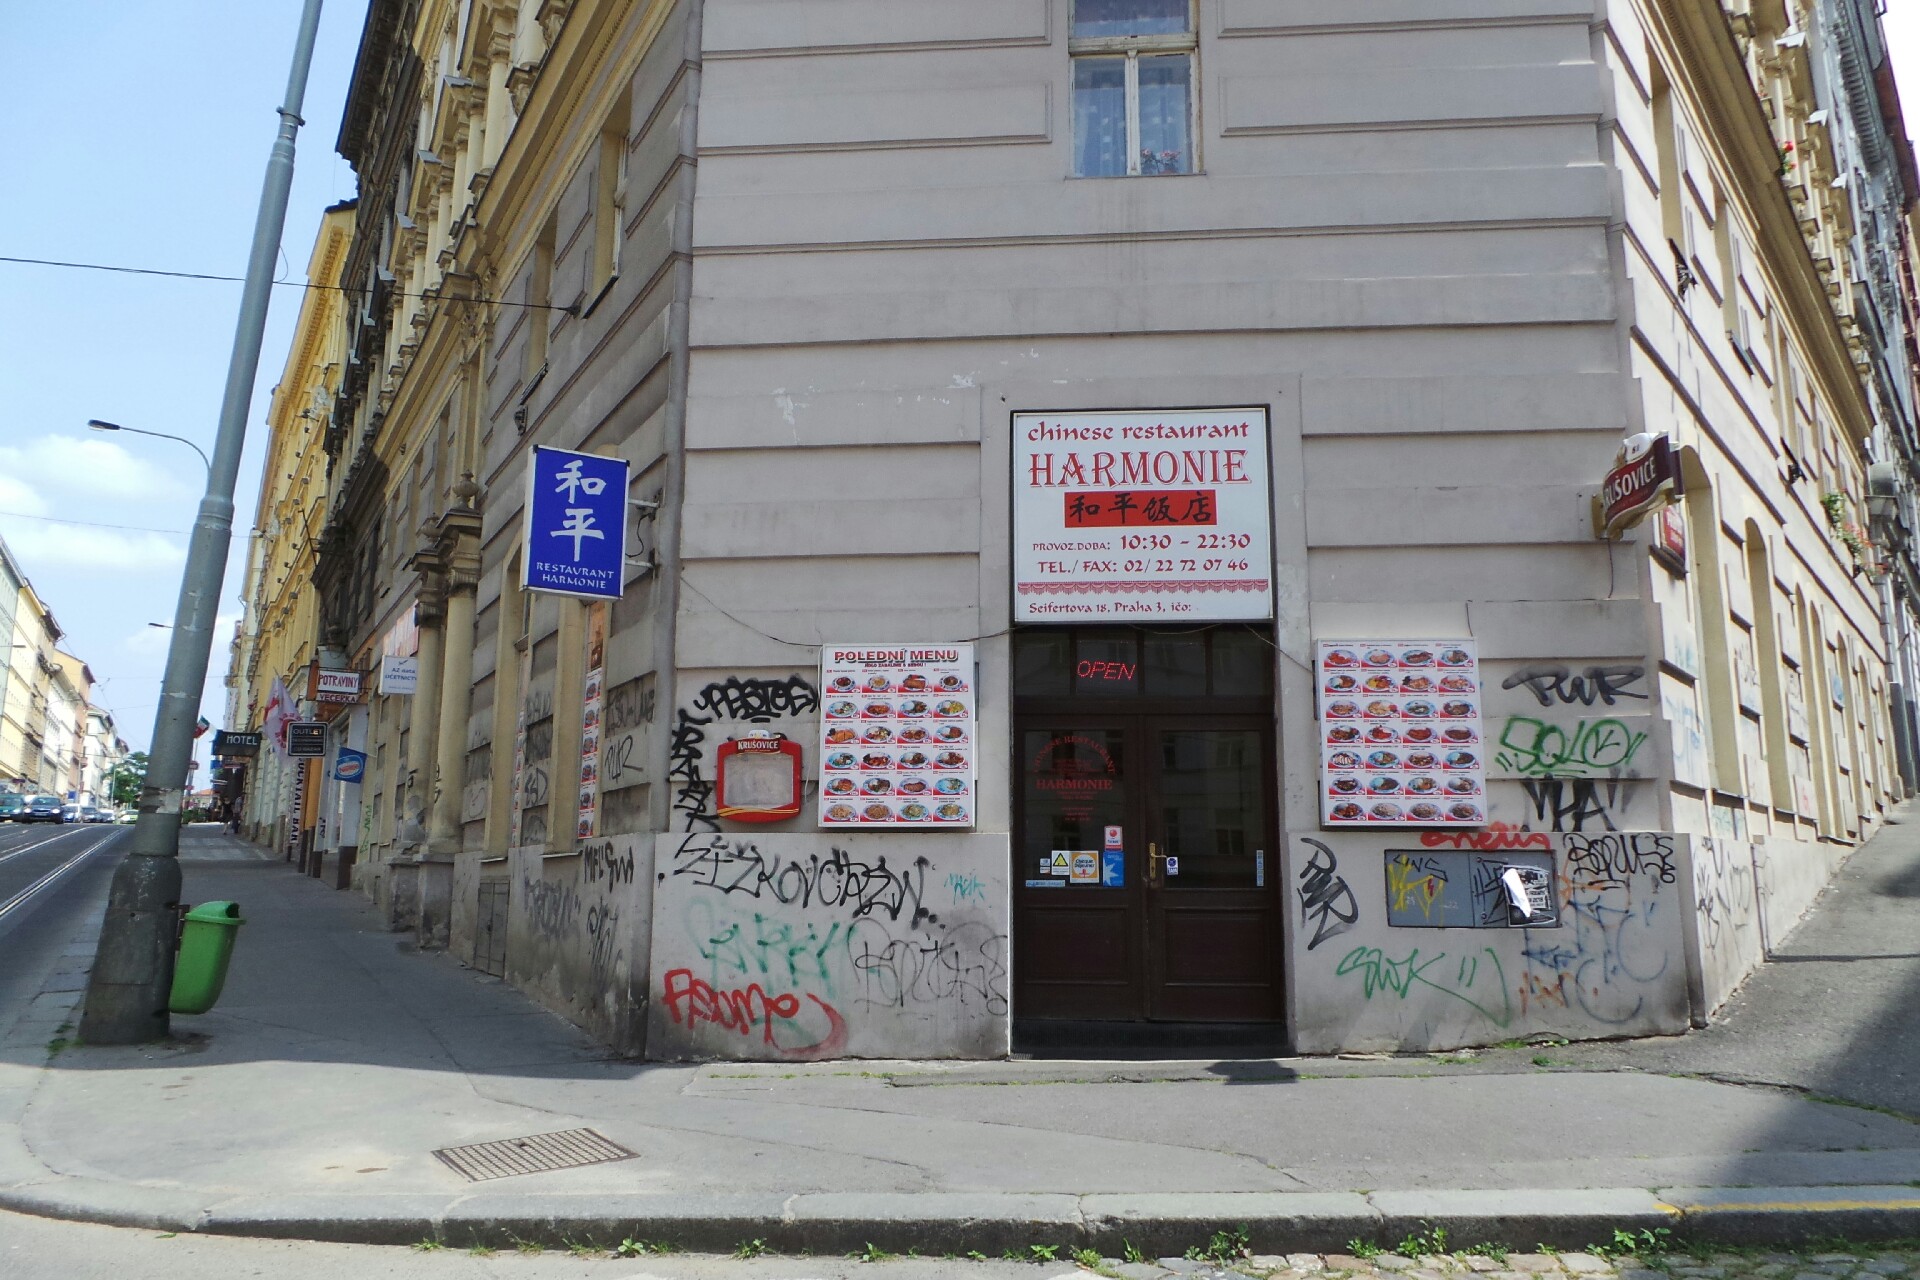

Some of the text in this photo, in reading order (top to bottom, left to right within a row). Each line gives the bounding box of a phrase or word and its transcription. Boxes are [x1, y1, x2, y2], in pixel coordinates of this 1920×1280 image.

[1027, 421, 1249, 442] chinese restaurant
[1028, 449, 1252, 488] HARMONIE
[1069, 491, 1212, 525] 和平饭店
[1120, 535, 1172, 551] 10:30
[1197, 534, 1251, 550] 22:30
[536, 562, 614, 579] RESTAURANT
[1083, 560, 1118, 573] FAX:
[1155, 559, 1174, 572] 22
[1179, 559, 1197, 572] 72
[1203, 559, 1222, 572] 07
[1227, 557, 1249, 572] 46
[542, 573, 607, 589] HARMONIE
[1029, 601, 1093, 614] Seifertova
[1114, 600, 1153, 613] Praha
[834, 648, 958, 662] POLEDNÍ MENU
[1077, 660, 1137, 681] OPEN
[318, 674, 358, 688] POTRAVINY
[226, 734, 258, 746] HOTEL
[1036, 779, 1113, 790] HARMONIE
[290, 817, 299, 841] BAR
